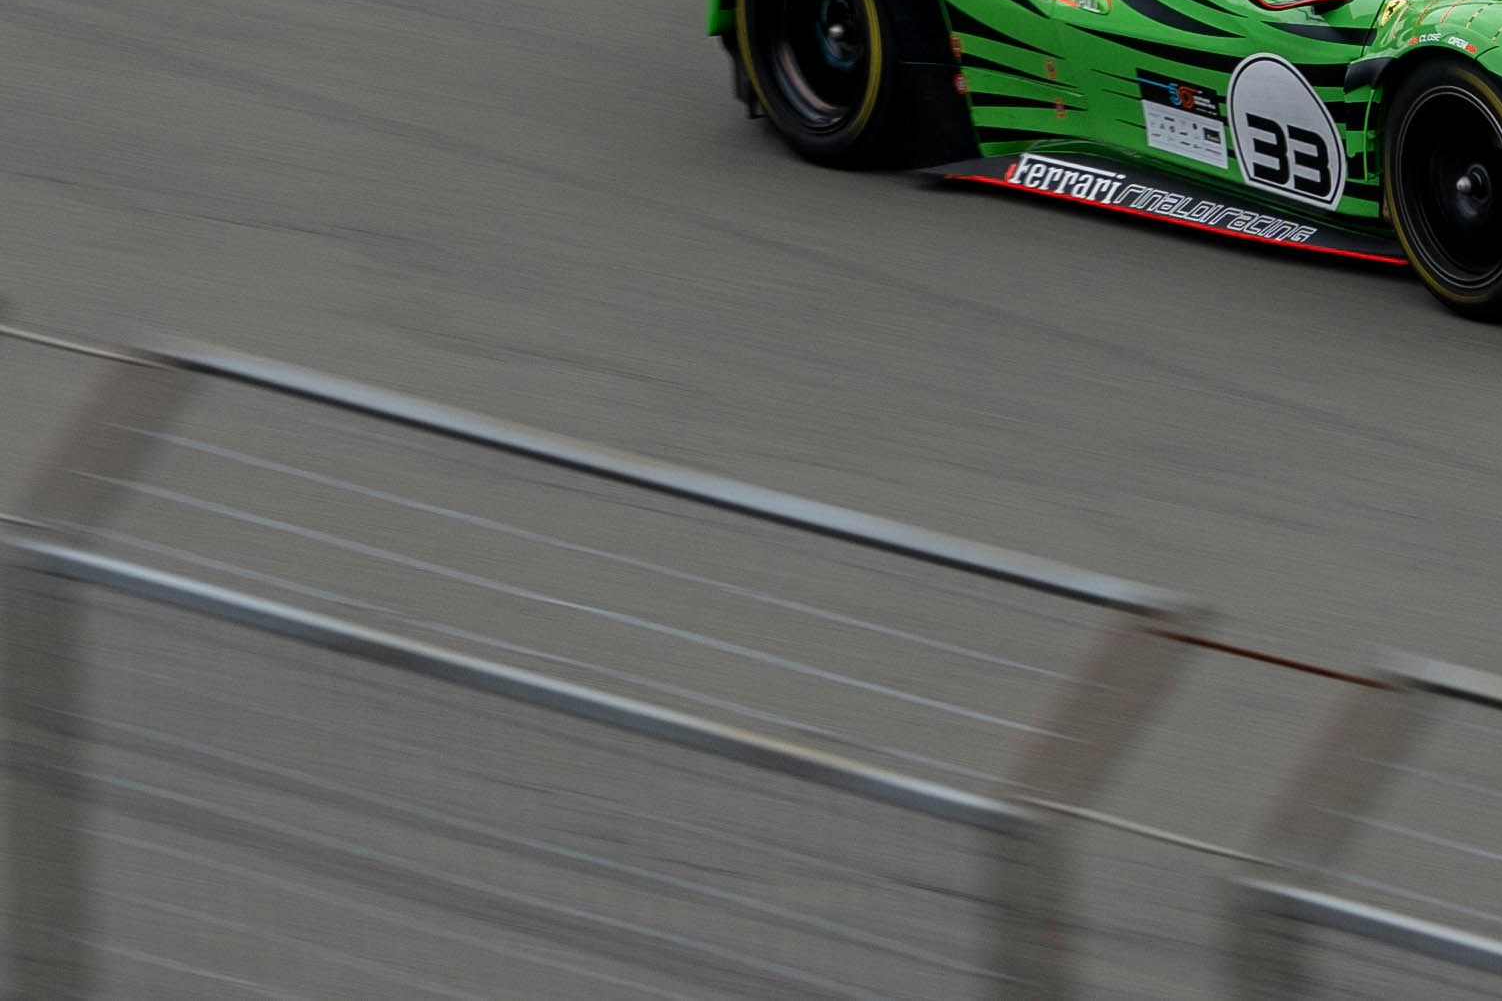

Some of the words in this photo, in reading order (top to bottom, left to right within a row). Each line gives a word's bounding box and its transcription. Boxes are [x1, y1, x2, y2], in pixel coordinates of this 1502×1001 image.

[1419, 33, 1441, 42] CLOSE
[1448, 36, 1469, 50] OPEN
[1246, 112, 1332, 197] 33
[1010, 153, 1126, 204] Ferrari
